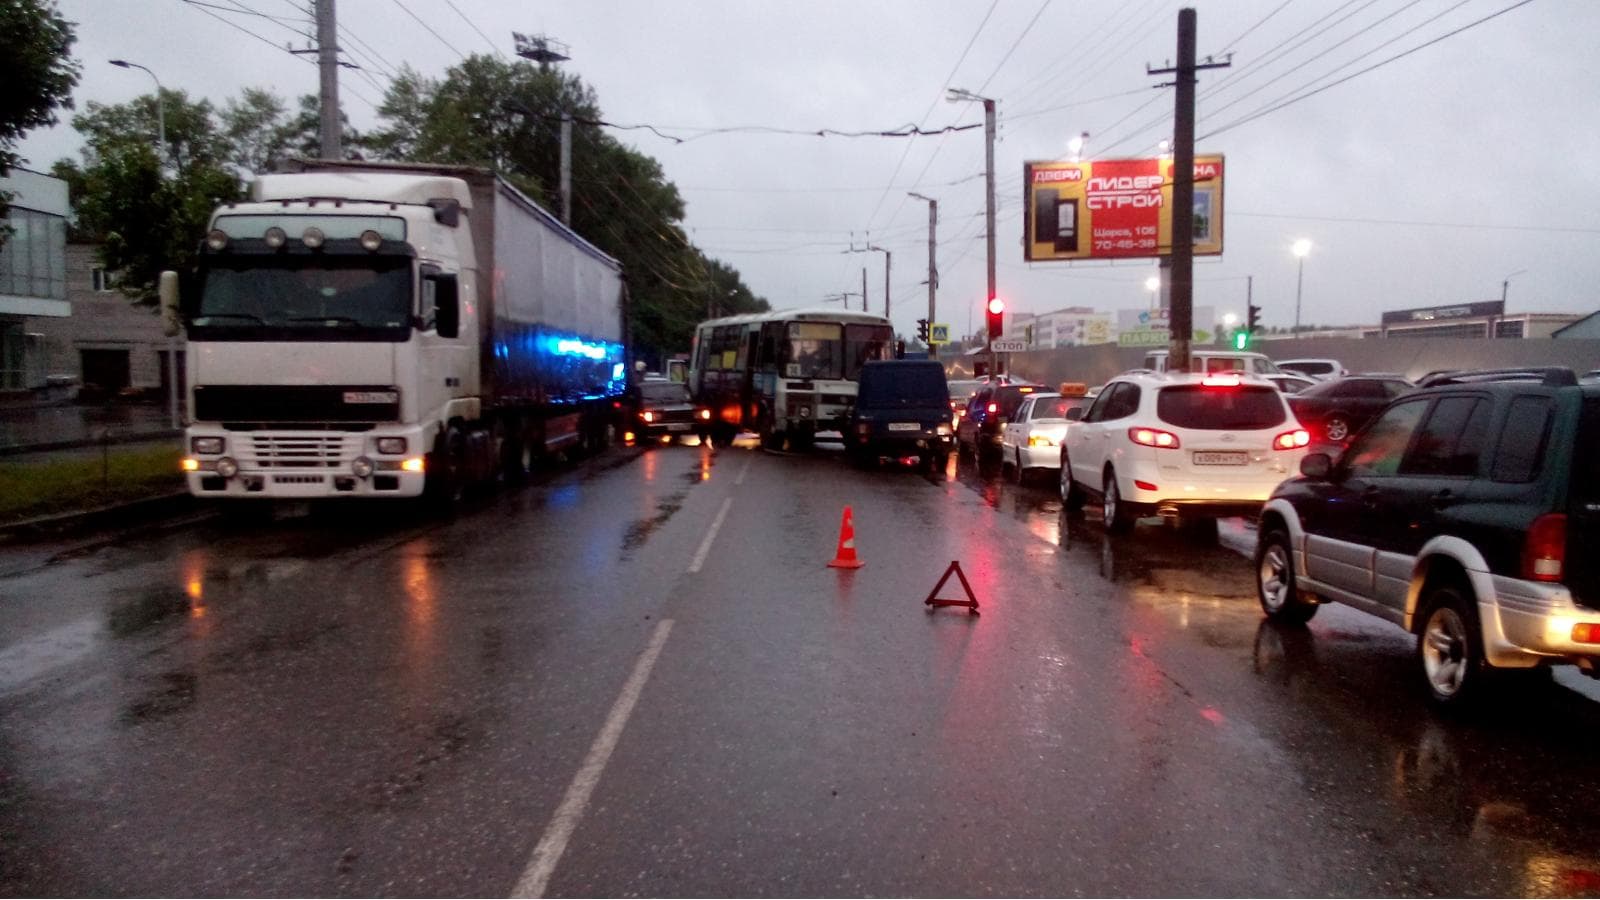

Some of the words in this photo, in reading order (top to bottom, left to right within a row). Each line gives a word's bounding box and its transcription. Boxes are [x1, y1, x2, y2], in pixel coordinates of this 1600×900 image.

[1035, 170, 1081, 183] ДВЕРИ
[1086, 175, 1164, 191] ЛИДЕР
[1087, 191, 1164, 209] СТРОЙ
[1122, 332, 1169, 344] ПАРКО
[994, 342, 1023, 350] СТОП
